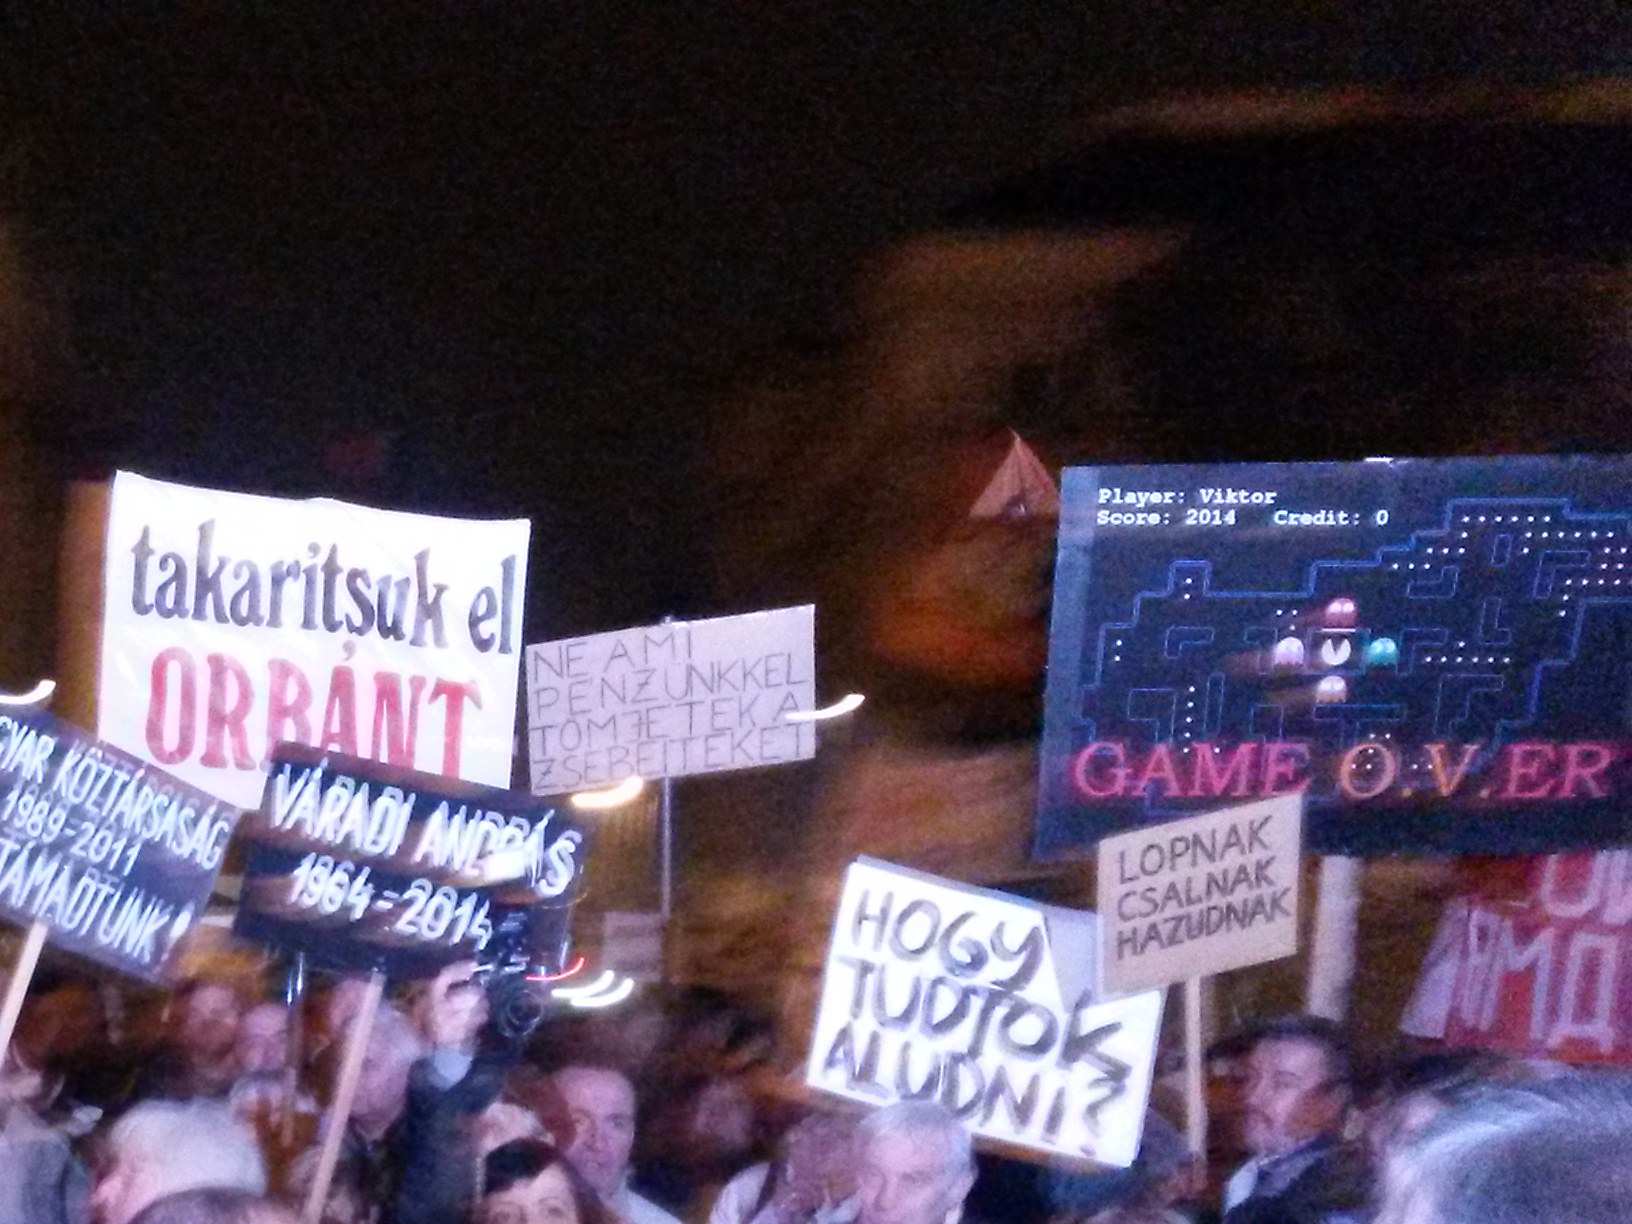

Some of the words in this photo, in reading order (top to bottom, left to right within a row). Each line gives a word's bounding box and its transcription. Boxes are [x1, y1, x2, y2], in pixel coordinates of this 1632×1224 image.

[1097, 488, 1185, 507] Player:
[1199, 488, 1277, 505] Viktor
[1097, 509, 1170, 526] Score:
[1185, 509, 1237, 526] 2014
[1273, 509, 1361, 526] Credit:
[1375, 509, 1389, 526] 0
[467, 554, 517, 655] el
[533, 641, 588, 683] NE
[145, 640, 483, 778] ORBÁNT
[1074, 740, 1312, 798] GAME
[2, 783, 143, 877] 1989-2011
[272, 760, 417, 858] VÁRADI
[1120, 814, 1273, 885] LOPNAK
[1116, 886, 1292, 961] HAZUDNAK
[1117, 855, 1277, 923] CSALNAK
[851, 888, 1047, 993] HOGY
[835, 954, 1132, 1071] TUDTOK
